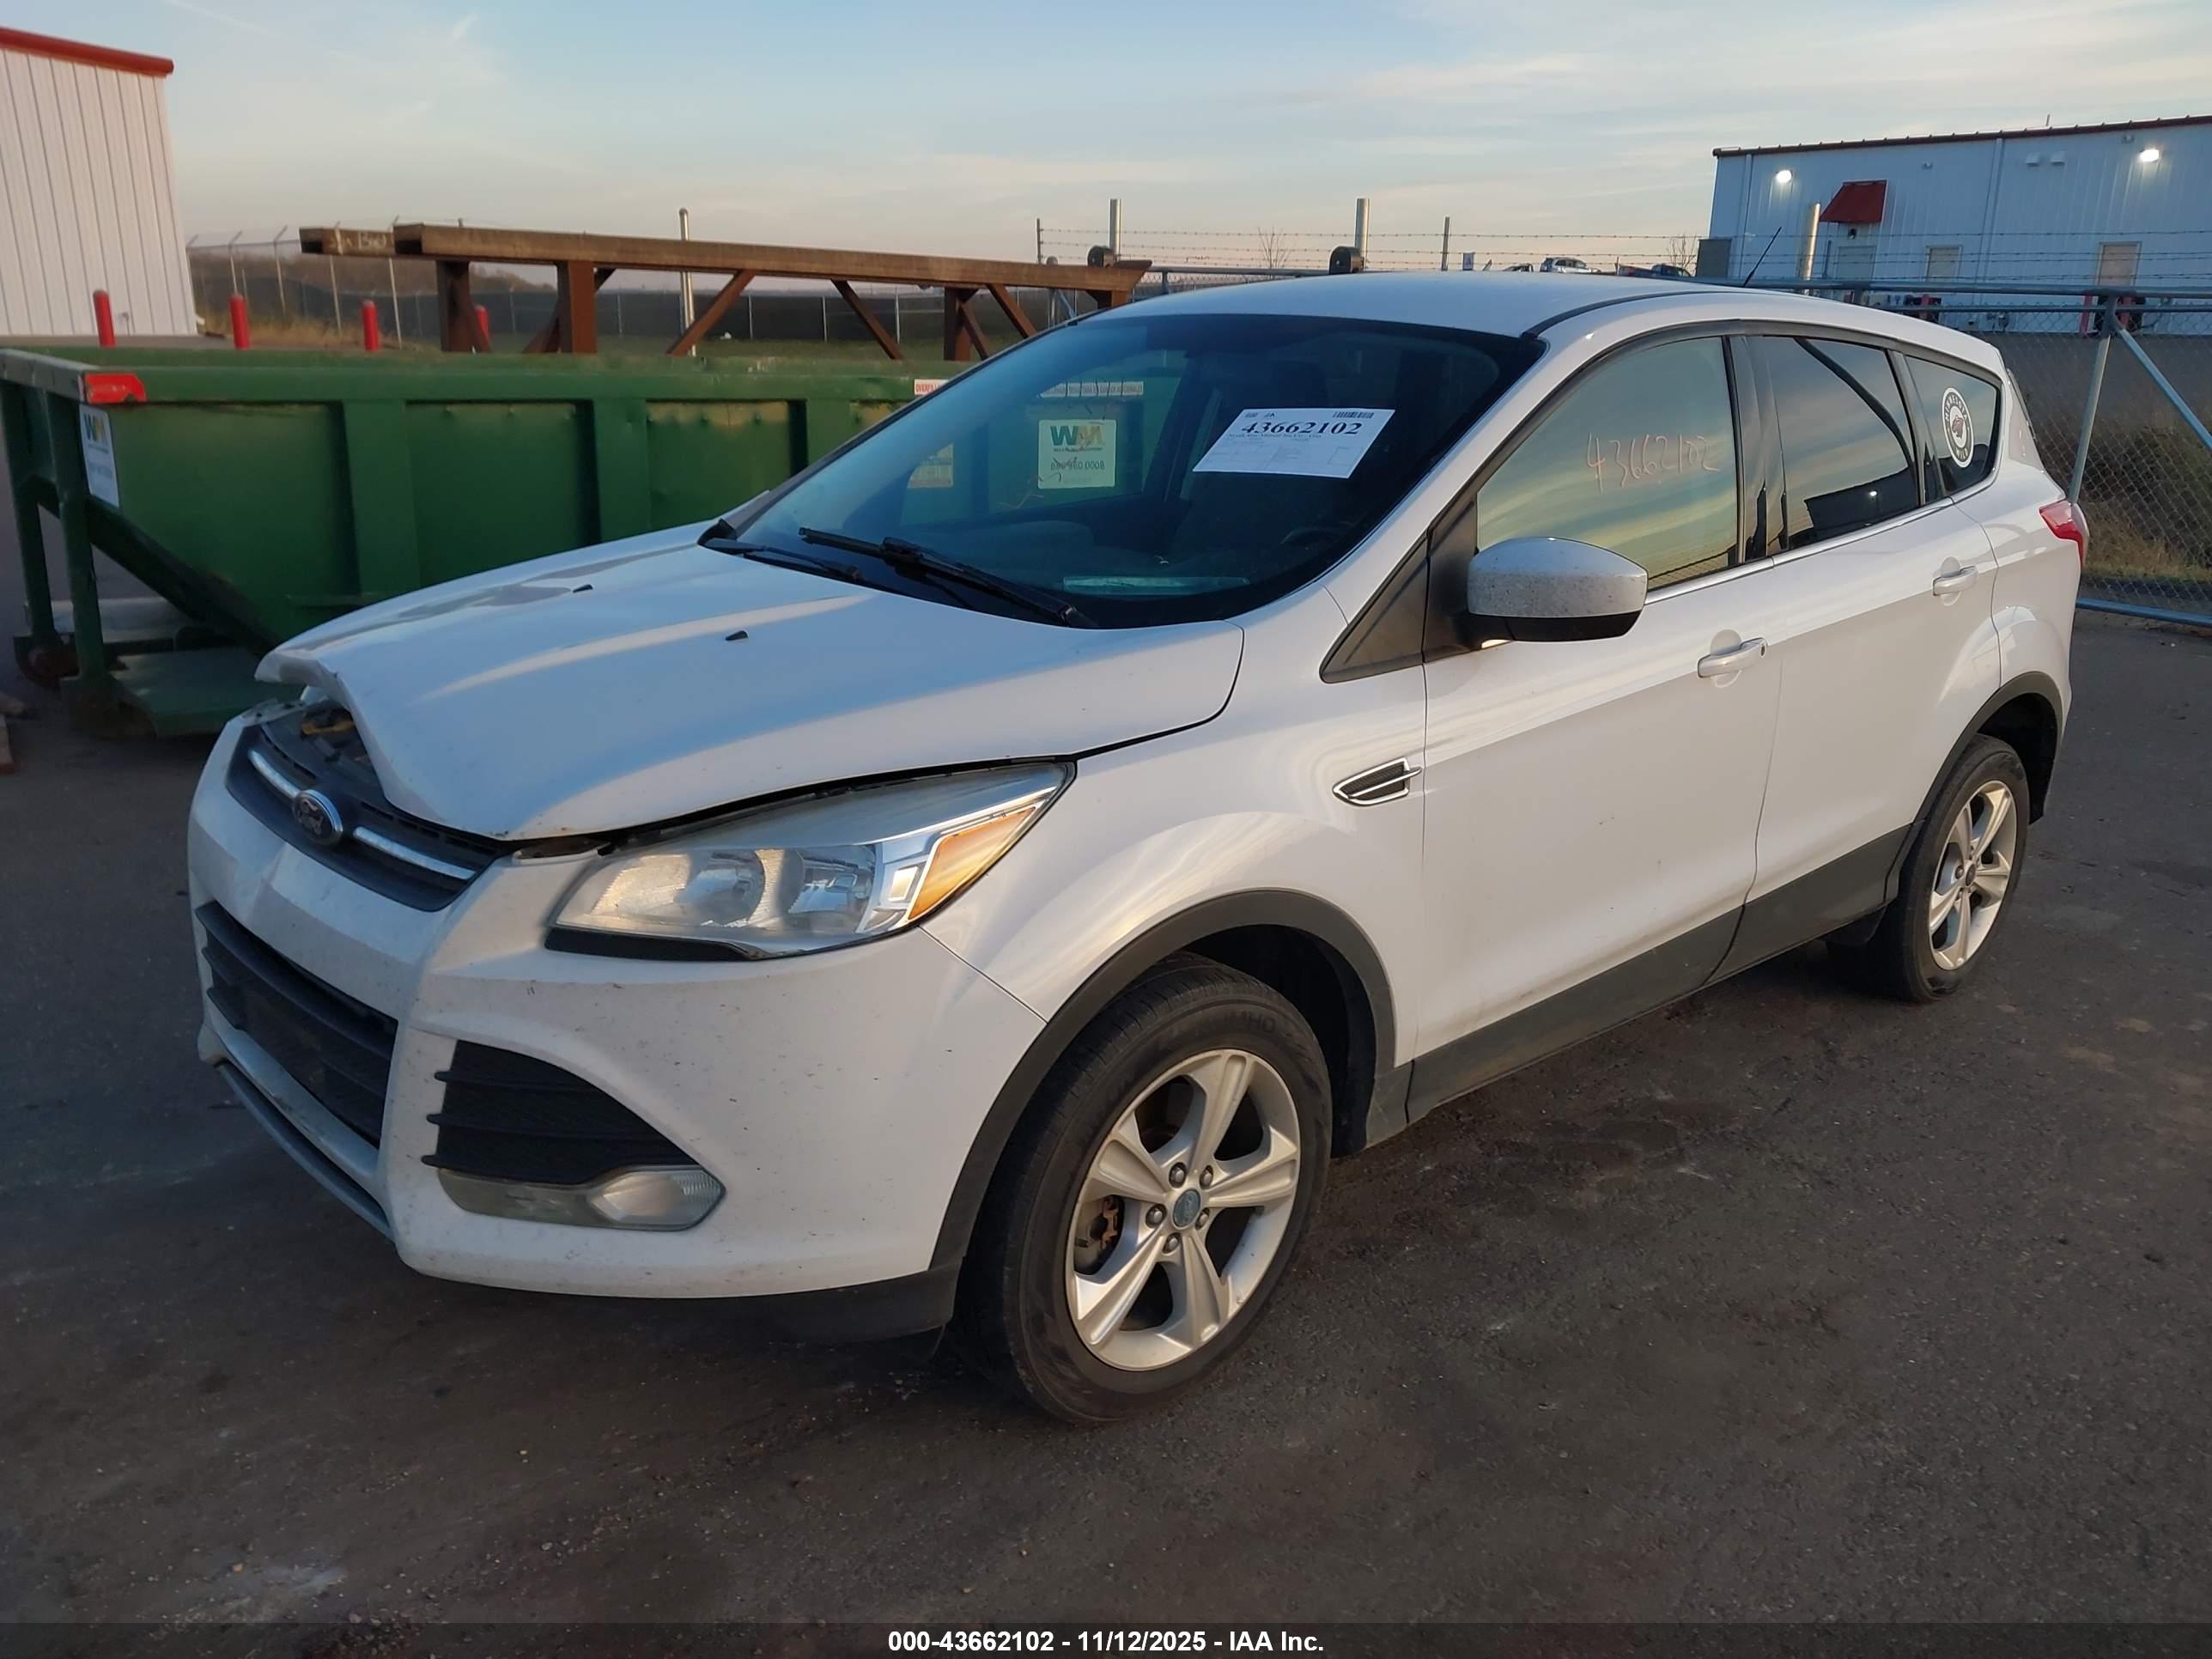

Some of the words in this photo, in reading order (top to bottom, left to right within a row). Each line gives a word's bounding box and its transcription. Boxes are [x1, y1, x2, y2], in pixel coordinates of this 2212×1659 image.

[1944, 395, 1967, 421] MINNESOTA
[1049, 425, 1104, 446] WM
[1242, 422, 1364, 434] 43662102
[1587, 432, 1721, 494] 43662102
[1955, 447, 1968, 459] WILD
